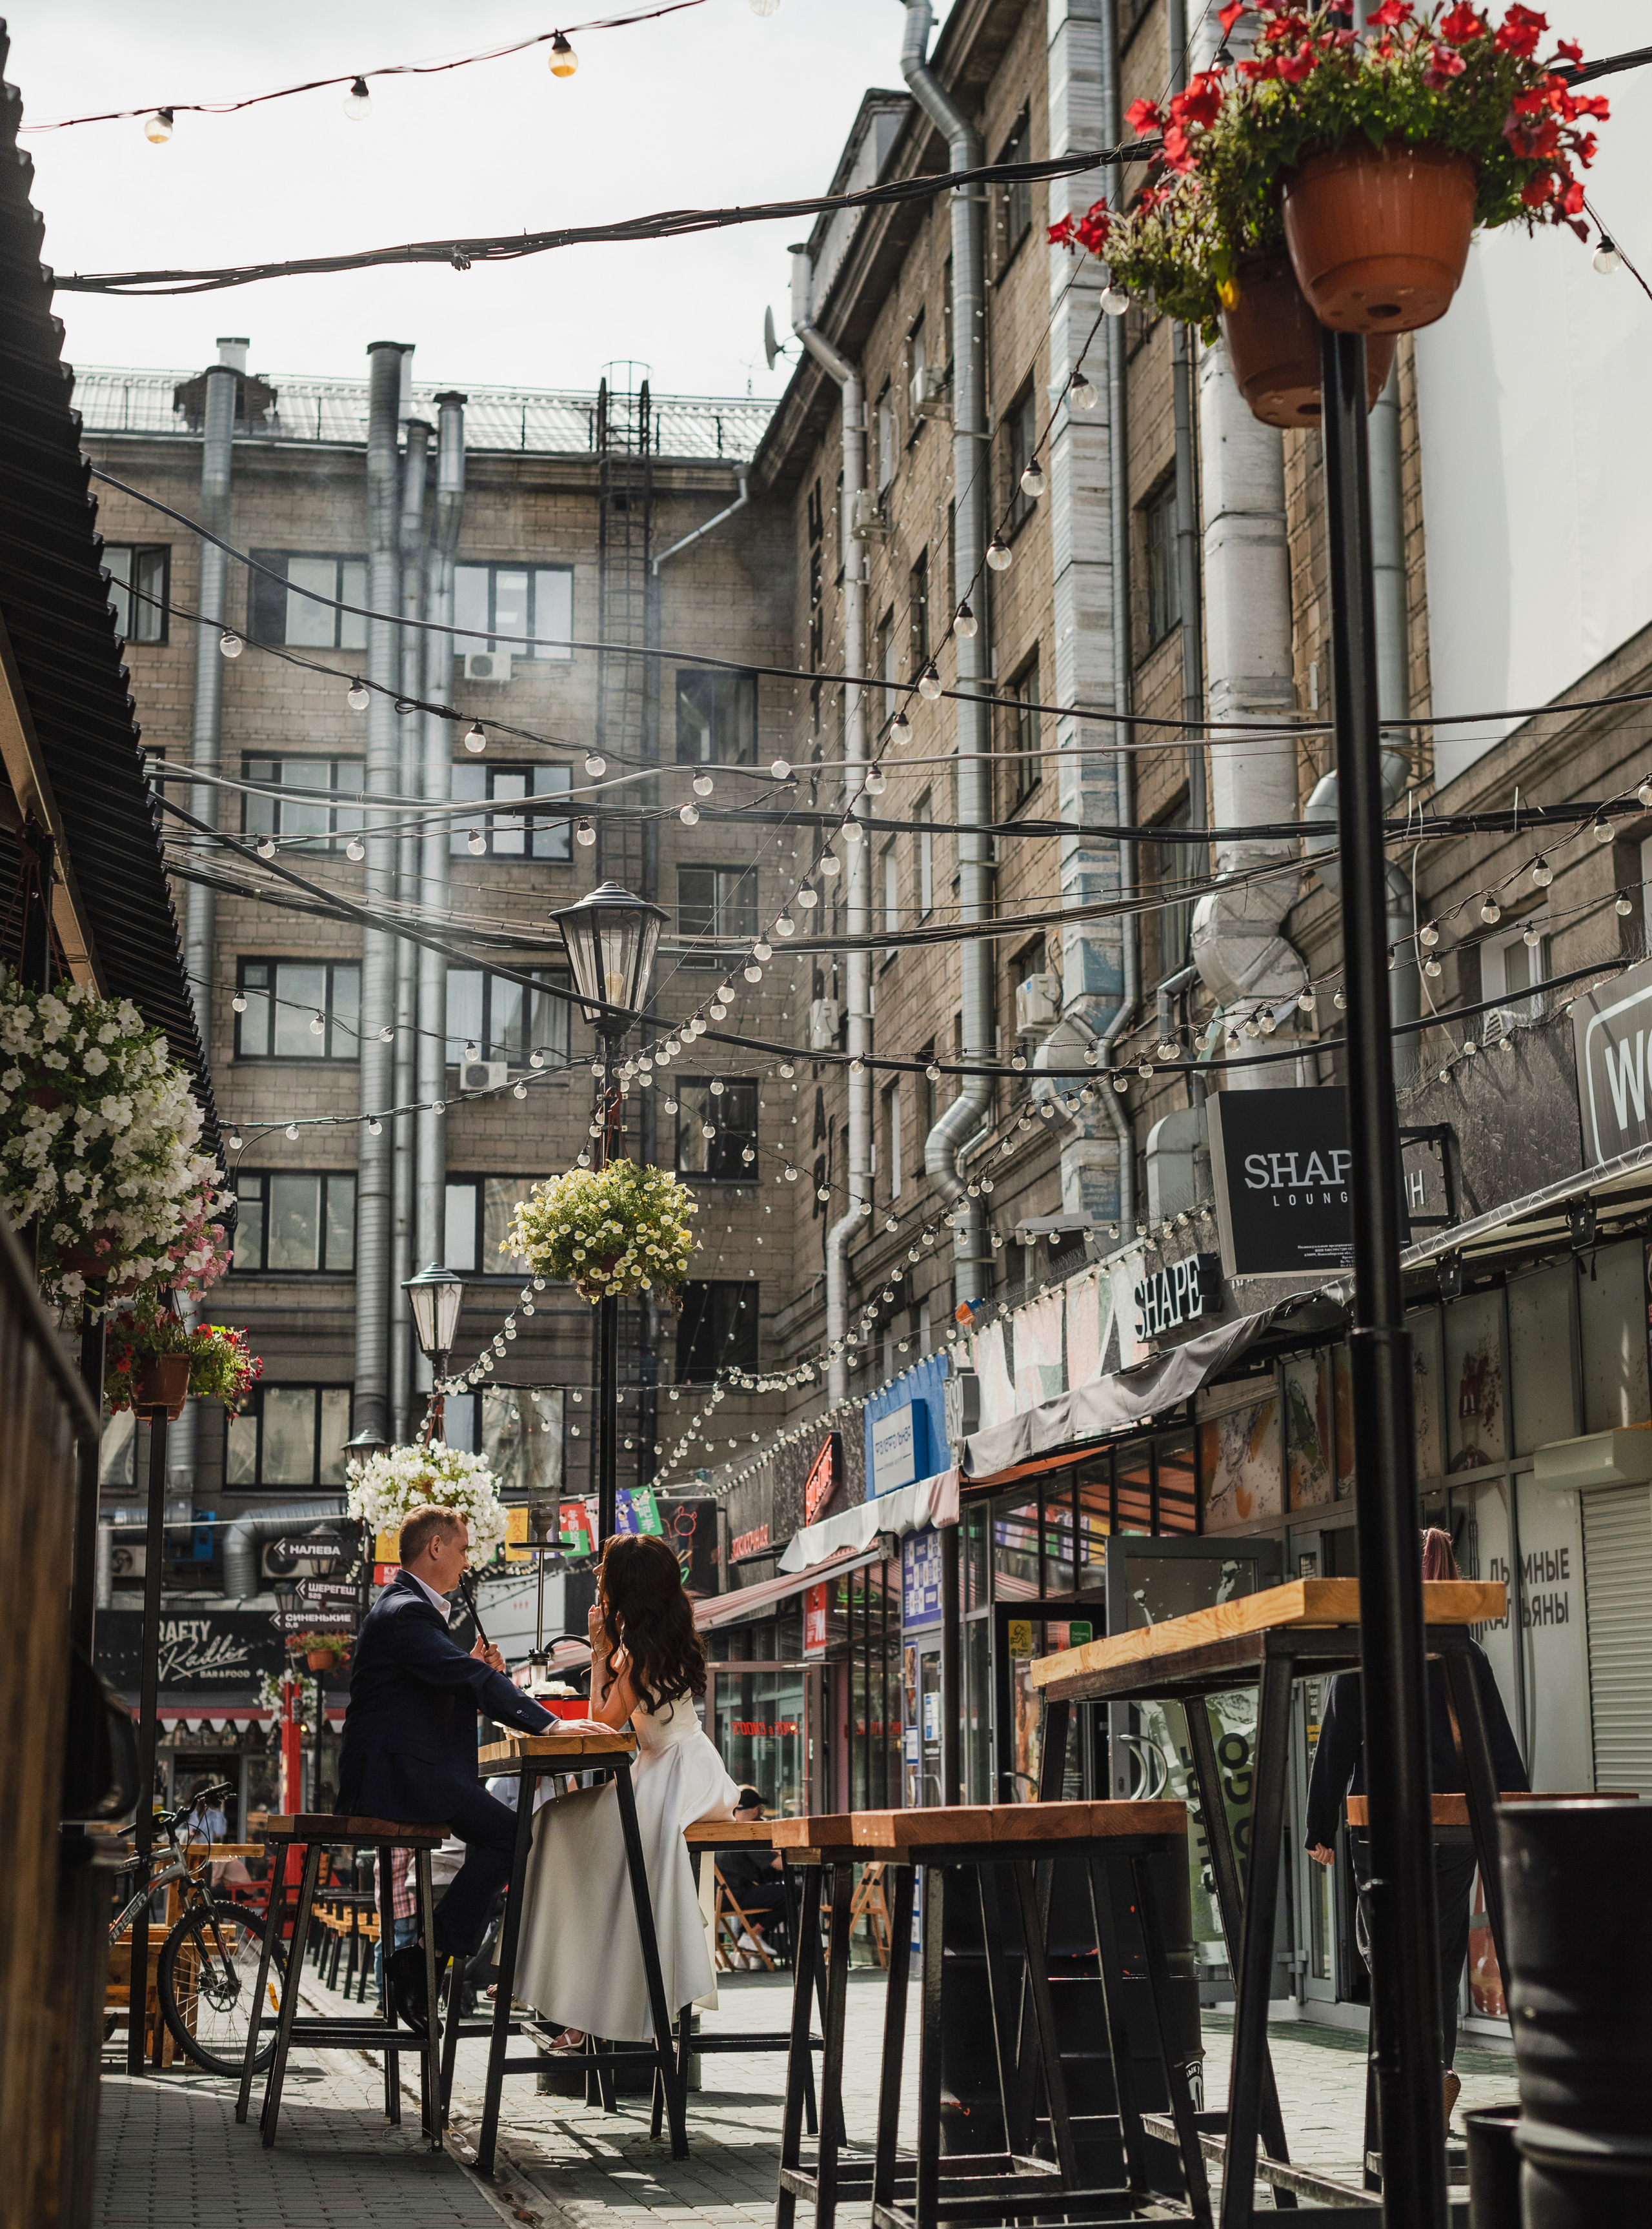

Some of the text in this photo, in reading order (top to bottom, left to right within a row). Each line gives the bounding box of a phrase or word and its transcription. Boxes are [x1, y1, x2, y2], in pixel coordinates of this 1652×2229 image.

[1604, 1029, 1652, 1131] W
[1244, 1150, 1353, 1189] SHAP
[1273, 1192, 1348, 1207] LOUNG
[1134, 1253, 1204, 1342] SHAPE
[290, 1545, 341, 1555] НАЛЕВА
[308, 1582, 356, 1596] ШЕРЕГЕШ
[285, 1614, 352, 1622] СИНЕНЬКИЕ
[159, 1620, 212, 1642] RAFTY
